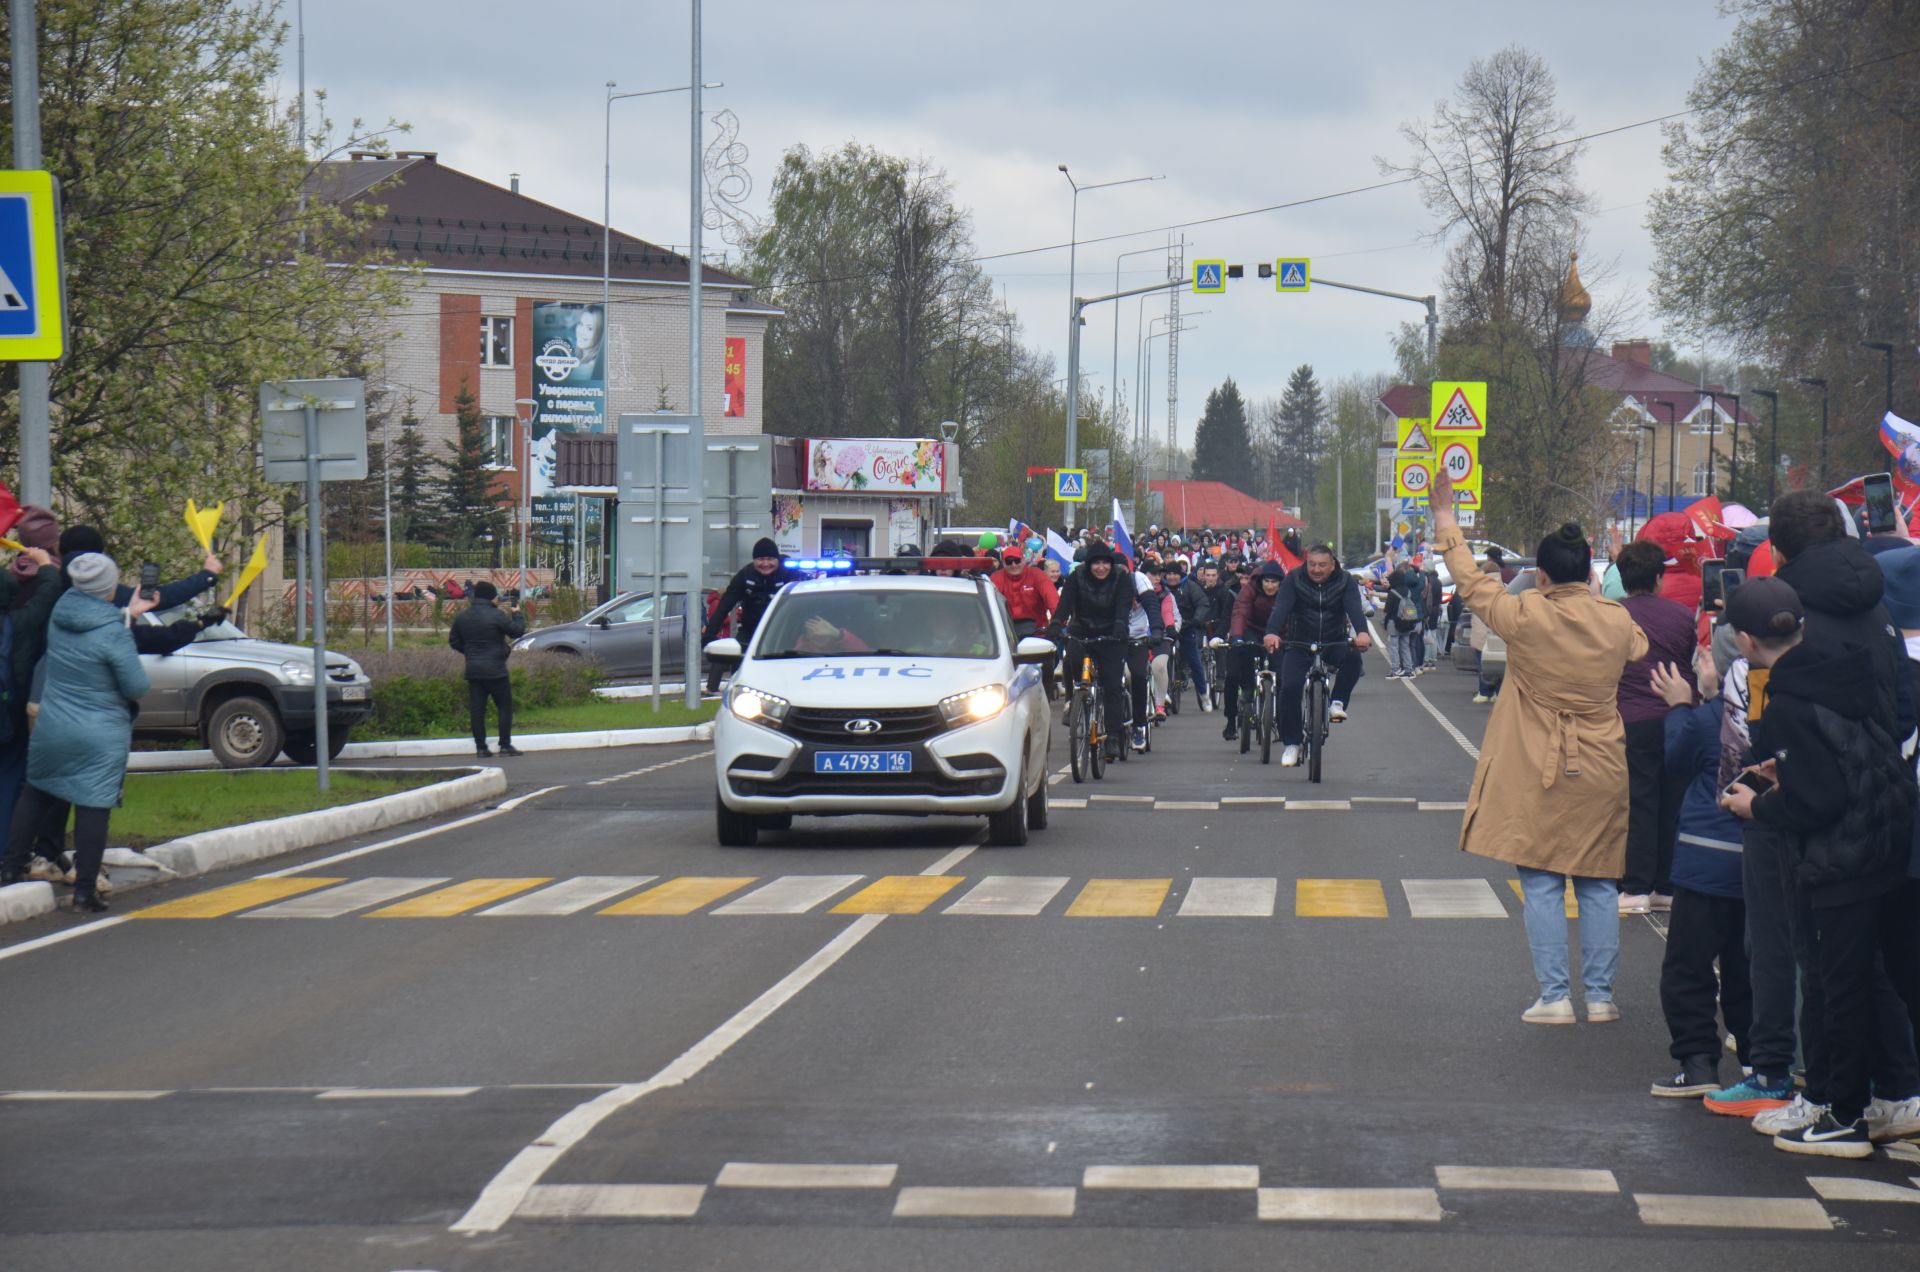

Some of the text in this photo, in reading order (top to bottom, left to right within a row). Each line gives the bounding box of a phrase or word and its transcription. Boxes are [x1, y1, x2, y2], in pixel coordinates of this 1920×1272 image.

[539, 383, 604, 398] Уверенность
[547, 399, 596, 411] с первых
[873, 455, 909, 484] Оазис
[1449, 456, 1465, 470] 40
[1407, 472, 1424, 484] 20
[802, 667, 933, 681] ДПС
[824, 753, 905, 770] А 4793 16
